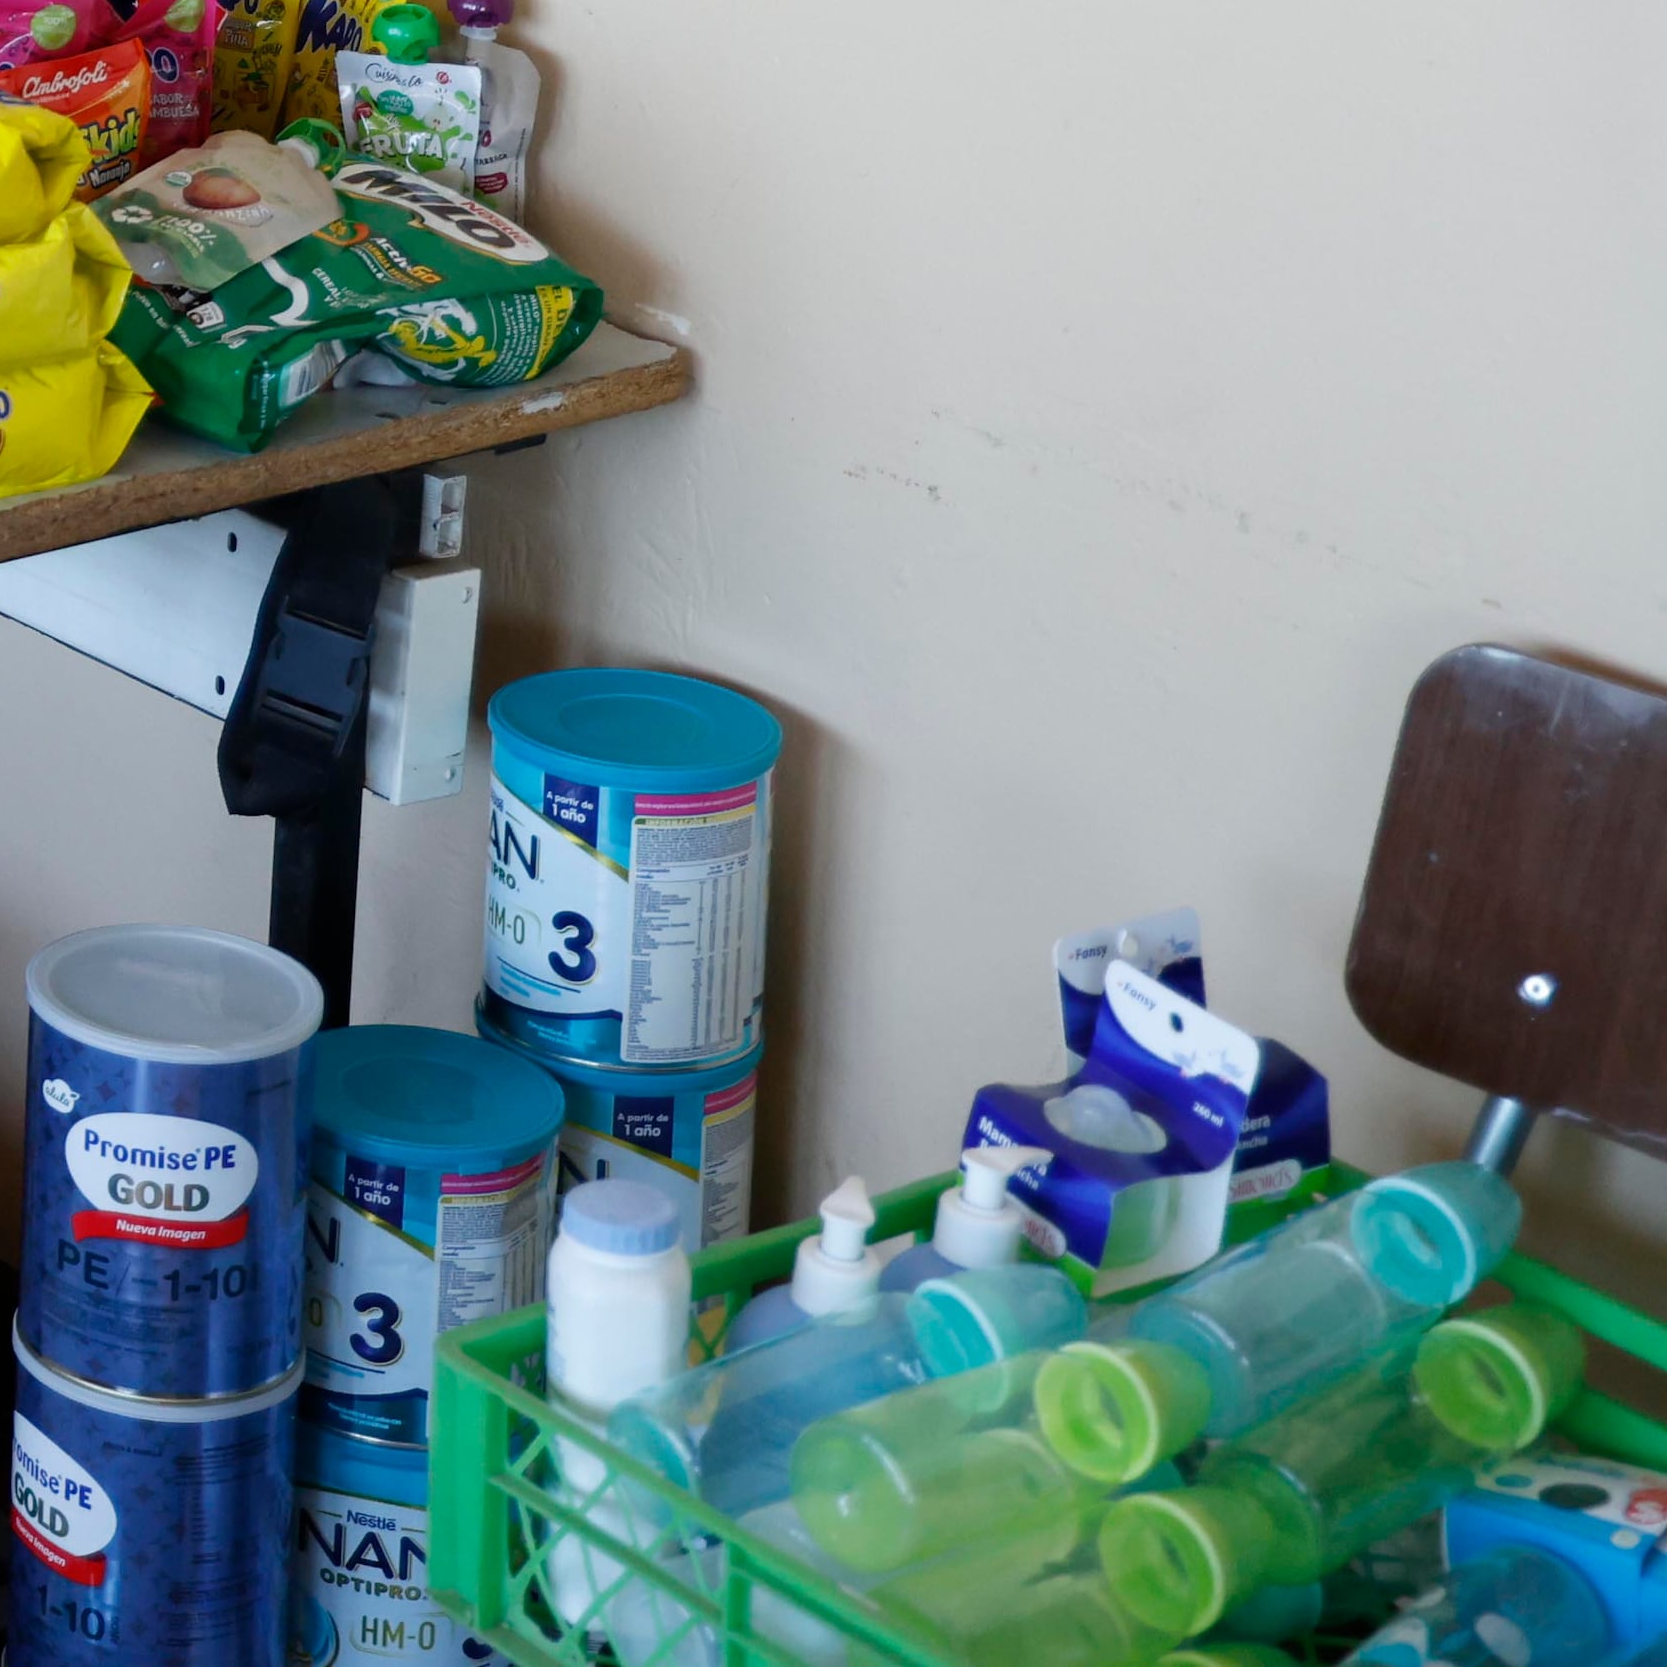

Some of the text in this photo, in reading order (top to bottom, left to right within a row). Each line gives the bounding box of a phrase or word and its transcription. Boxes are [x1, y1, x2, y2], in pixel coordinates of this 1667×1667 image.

[20, 59, 108, 100] Ambrosoli
[89, 161, 131, 189] Naranja
[341, 169, 517, 250] MILO
[547, 791, 594, 809] A partir de
[552, 803, 586, 824] 1 año
[548, 910, 597, 984] 3
[1074, 943, 1108, 961] Fansy
[1123, 983, 1157, 1011] Fansy
[625, 1124, 662, 1137] 1 año
[626, 1112, 653, 1125] partir
[655, 1111, 669, 1123] de
[83, 1128, 237, 1172] Promise PE
[106, 1172, 210, 1213] GOLD
[348, 1171, 400, 1192] A partir de
[353, 1187, 392, 1206] 1 año
[116, 1218, 207, 1242] Nueva Imagen
[348, 1291, 403, 1367] 3
[13, 1471, 69, 1540] GOLD
[346, 1509, 397, 1532] Nestlé
